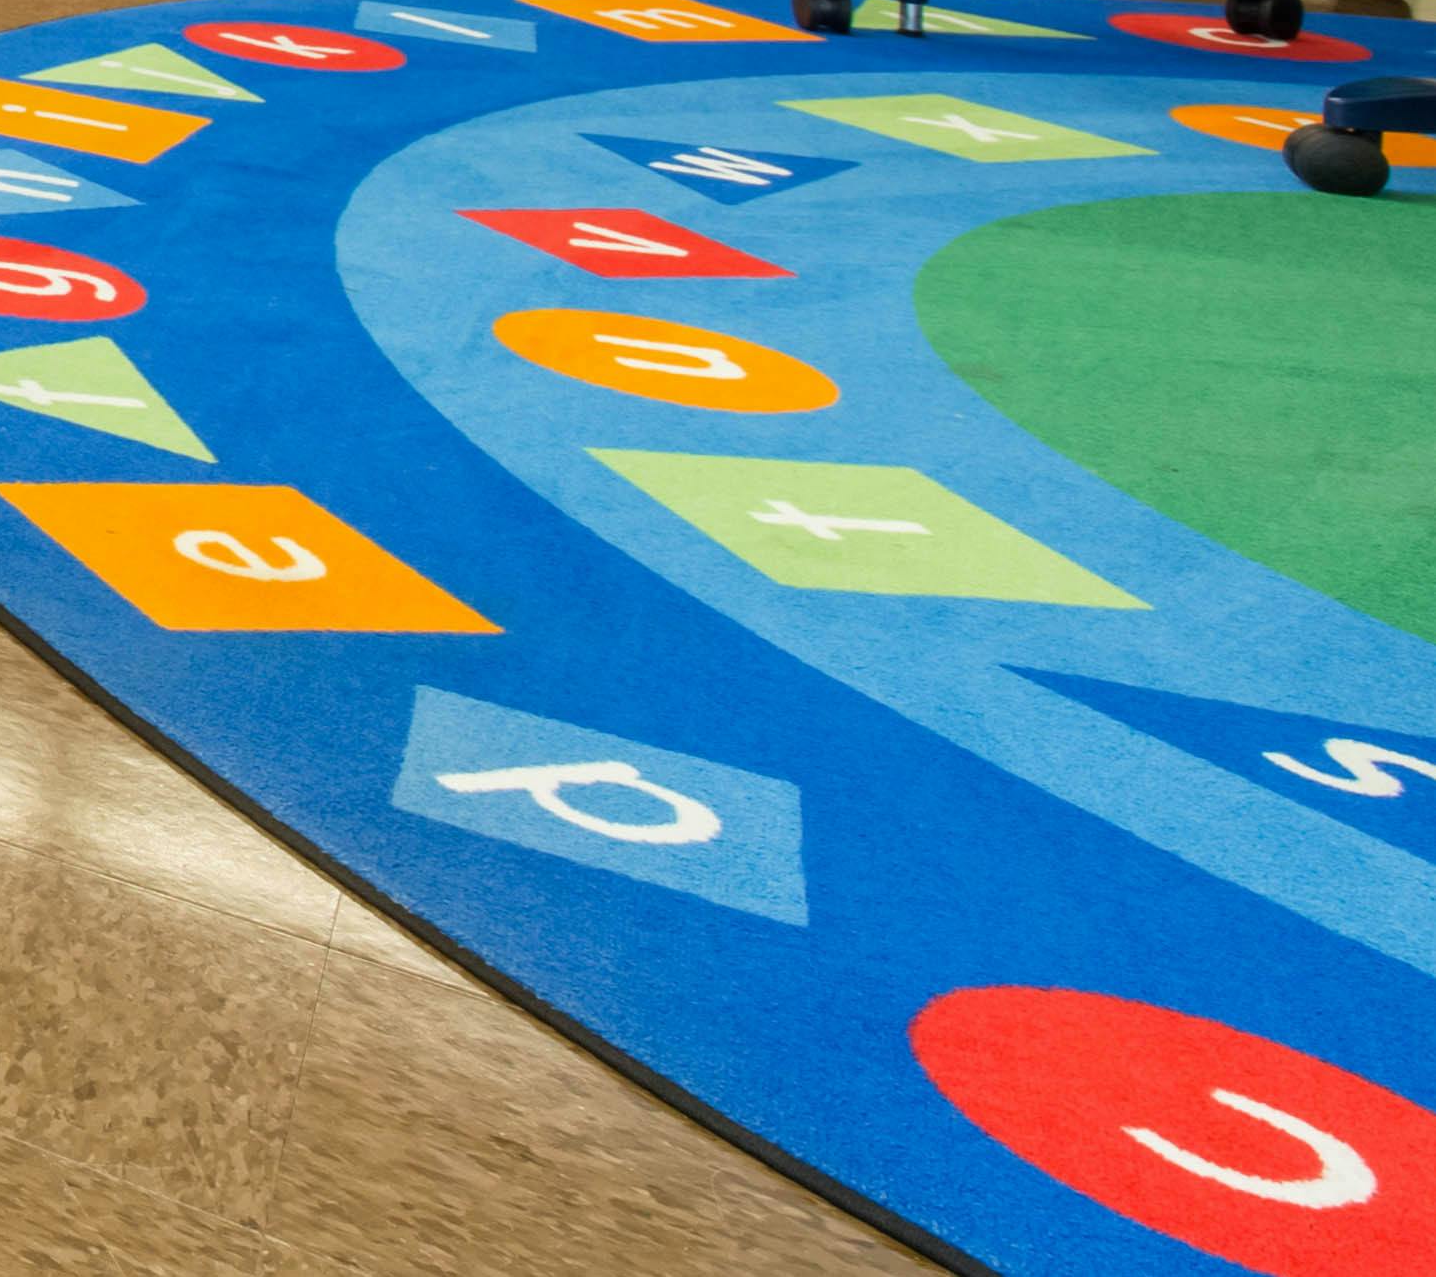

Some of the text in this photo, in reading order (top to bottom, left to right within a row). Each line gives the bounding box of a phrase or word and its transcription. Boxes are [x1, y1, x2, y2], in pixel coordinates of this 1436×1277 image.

[594, 7, 734, 31] m
[218, 31, 355, 59] k
[100, 59, 240, 98] j
[2, 103, 128, 132] i
[899, 113, 1041, 144] x
[648, 145, 794, 187] w
[568, 220, 689, 258] v
[592, 332, 749, 381] u
[747, 497, 934, 542] t
[174, 529, 327, 582] e
[1263, 737, 1436, 797] s
[433, 759, 724, 846] d
[1122, 1088, 1378, 1211] c
